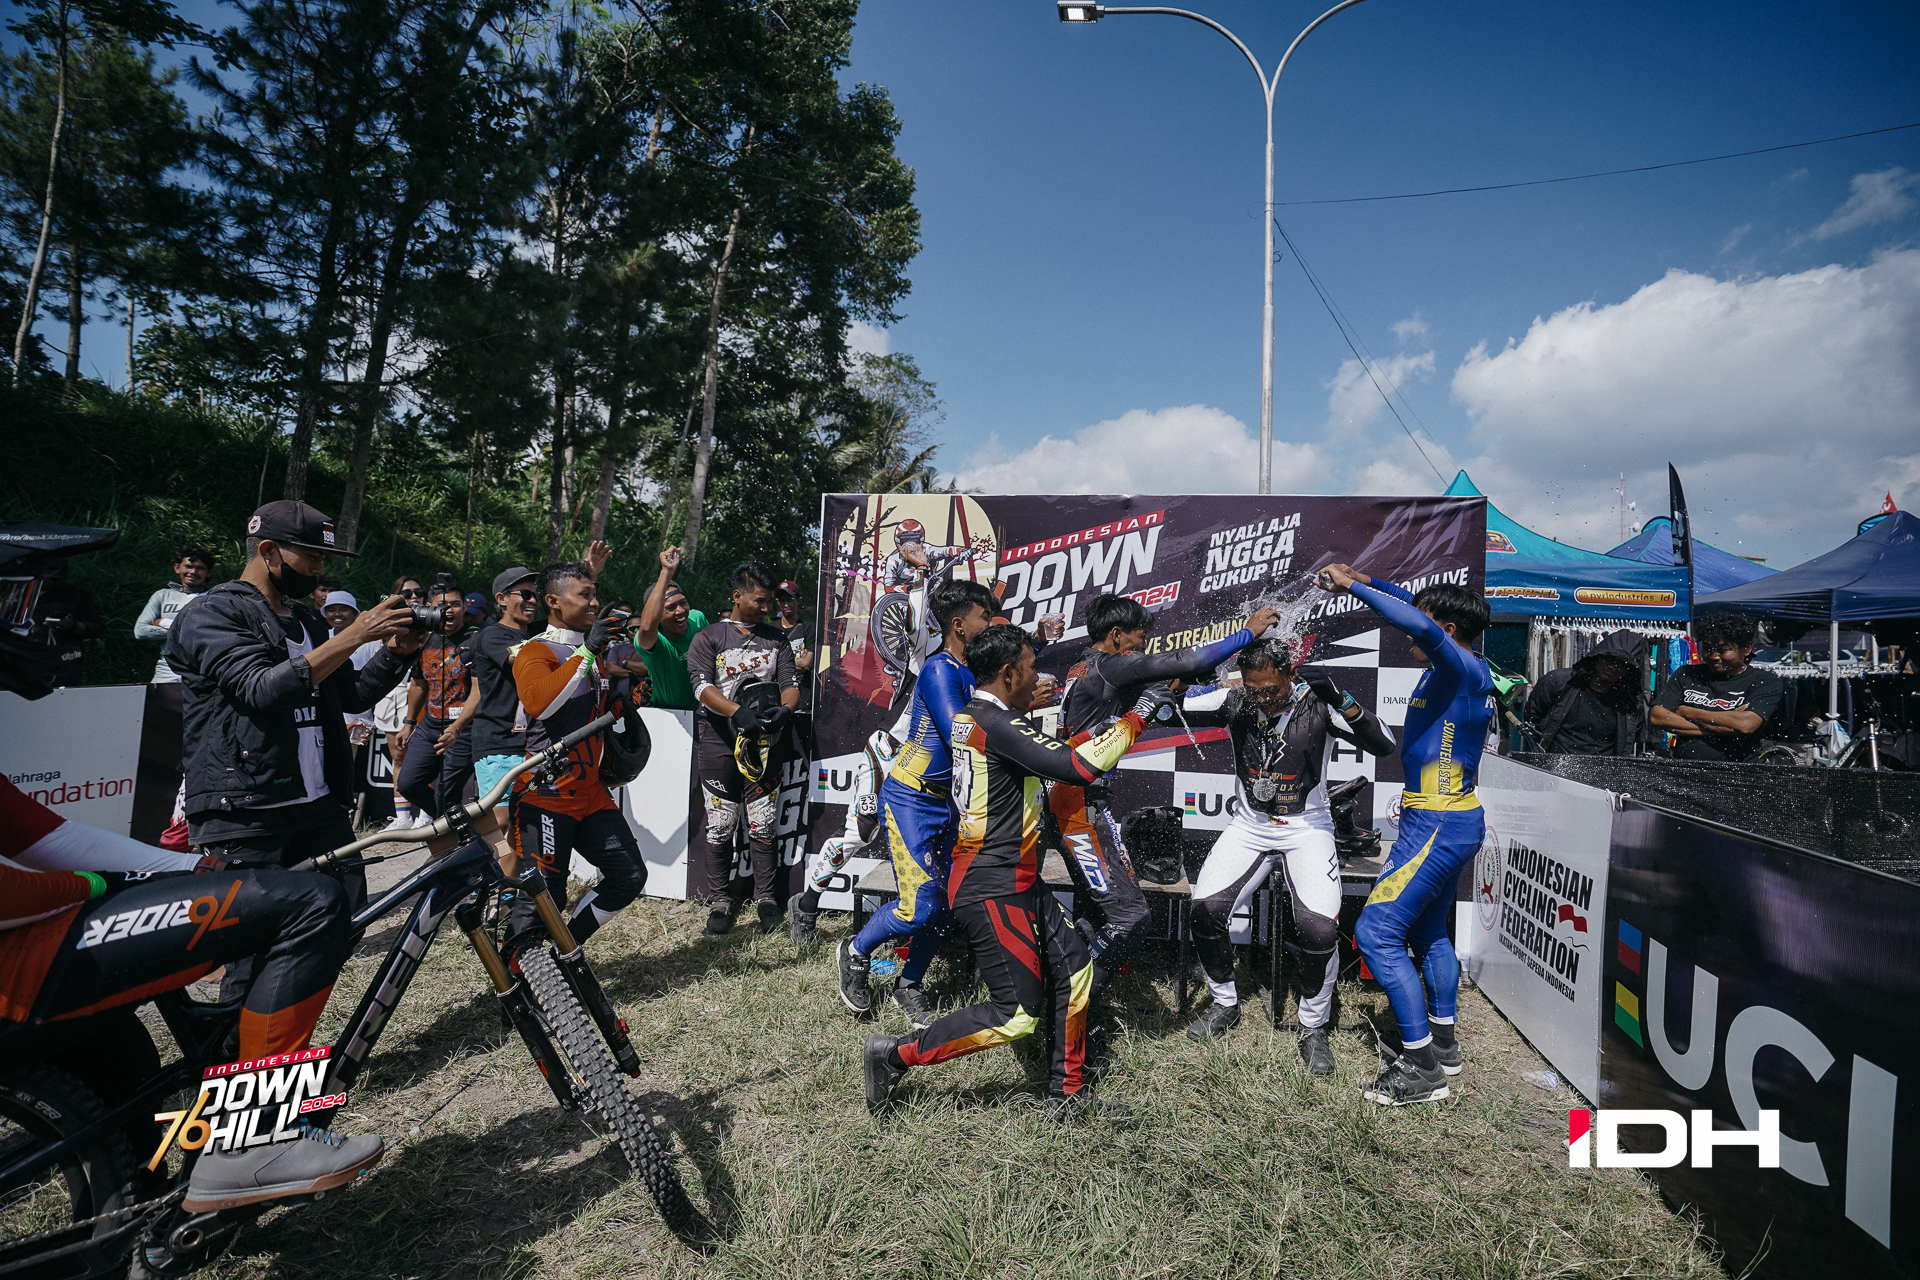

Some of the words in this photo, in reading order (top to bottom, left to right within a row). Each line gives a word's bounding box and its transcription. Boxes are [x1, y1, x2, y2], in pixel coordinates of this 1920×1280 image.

[1006, 512, 1158, 561] INDONESIAN
[1205, 529, 1295, 575] NGGA
[1210, 521, 1265, 548] NYALI
[1266, 512, 1301, 535] AJA
[998, 525, 1164, 610] DOWN
[1200, 563, 1268, 594] CUKUP
[1497, 588, 1559, 599] APPAREL
[1383, 696, 1411, 705] DJARU
[1438, 719, 1456, 769] SUMATERA
[8, 770, 62, 784] lahraga
[27, 777, 133, 807] ndation
[1438, 769, 1452, 796] SELA
[1507, 837, 1594, 912] INDONESIAN
[1503, 870, 1558, 931] CYCLING
[1500, 900, 1580, 985] FEDERATION
[1513, 944, 1527, 965] SPORT
[1526, 955, 1545, 979] SEPEDA
[1545, 970, 1576, 1003] INDONESIA
[1646, 937, 1898, 1250] UCI
